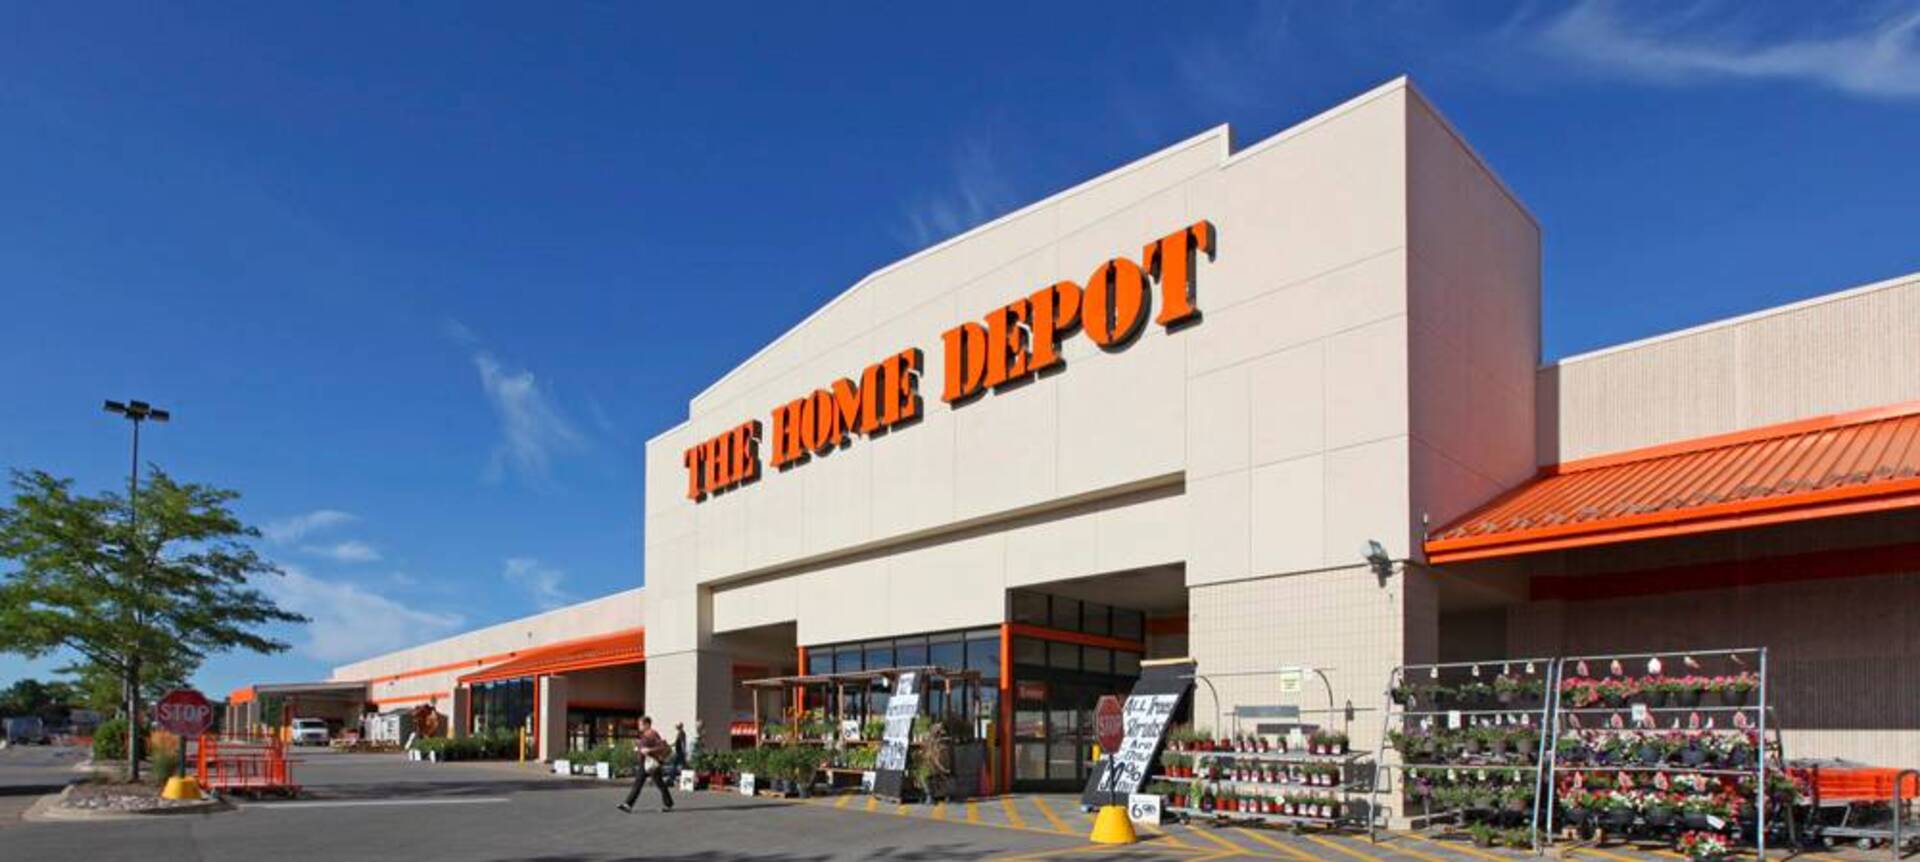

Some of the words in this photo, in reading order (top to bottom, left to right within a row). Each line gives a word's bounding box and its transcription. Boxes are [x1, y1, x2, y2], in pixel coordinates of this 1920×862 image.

[685, 420, 761, 503] THE
[771, 347, 923, 471] HOME
[941, 220, 1216, 410] DEPOT
[160, 703, 210, 722] STOP
[1099, 715, 1121, 736] STOP
